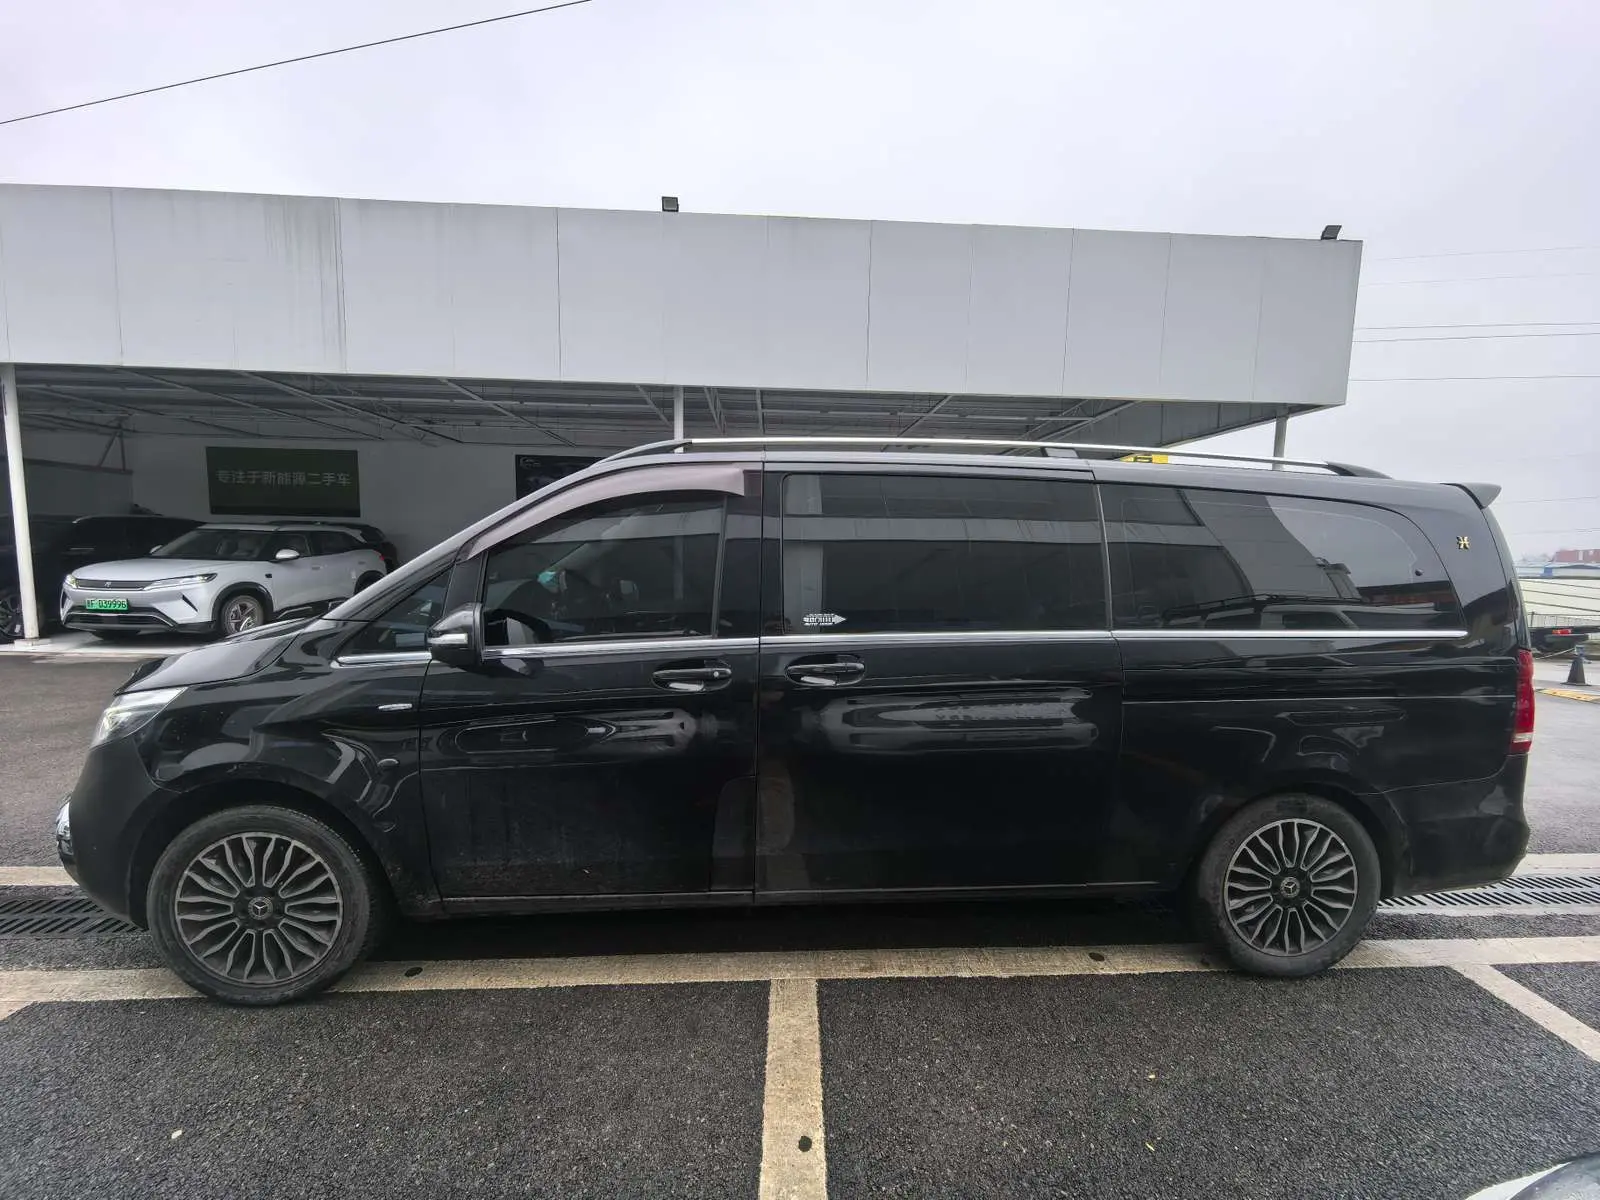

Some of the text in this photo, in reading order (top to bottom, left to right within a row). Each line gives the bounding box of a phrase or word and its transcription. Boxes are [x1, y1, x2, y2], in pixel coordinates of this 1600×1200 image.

[216, 469, 352, 488] 专注于新能源二手车
